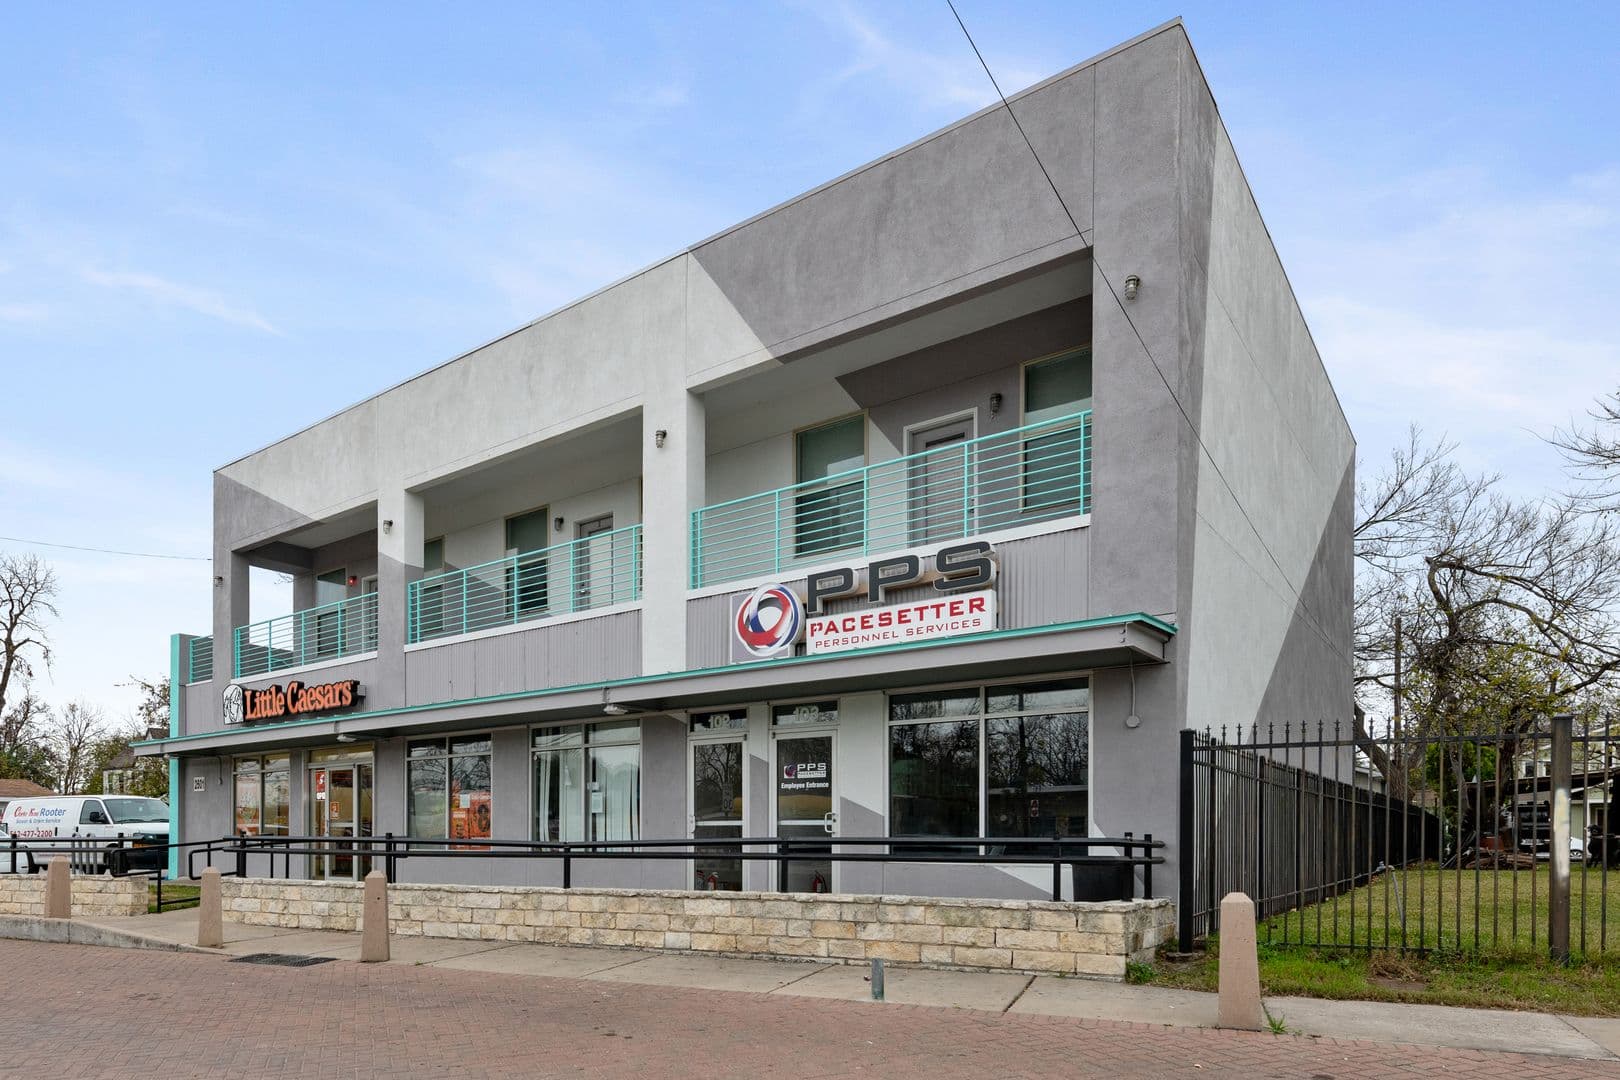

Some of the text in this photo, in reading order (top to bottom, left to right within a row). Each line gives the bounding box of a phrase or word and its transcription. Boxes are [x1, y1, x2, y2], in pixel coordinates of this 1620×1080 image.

[807, 540, 997, 614] PPS
[810, 596, 987, 637] PACESETTER
[815, 618, 982, 649] PERSONNEL SERVICES
[244, 680, 353, 720] Little Caesars
[797, 762, 826, 771] PPS
[781, 781, 829, 790] Employee Entrance
[40, 808, 66, 816] Rooter
